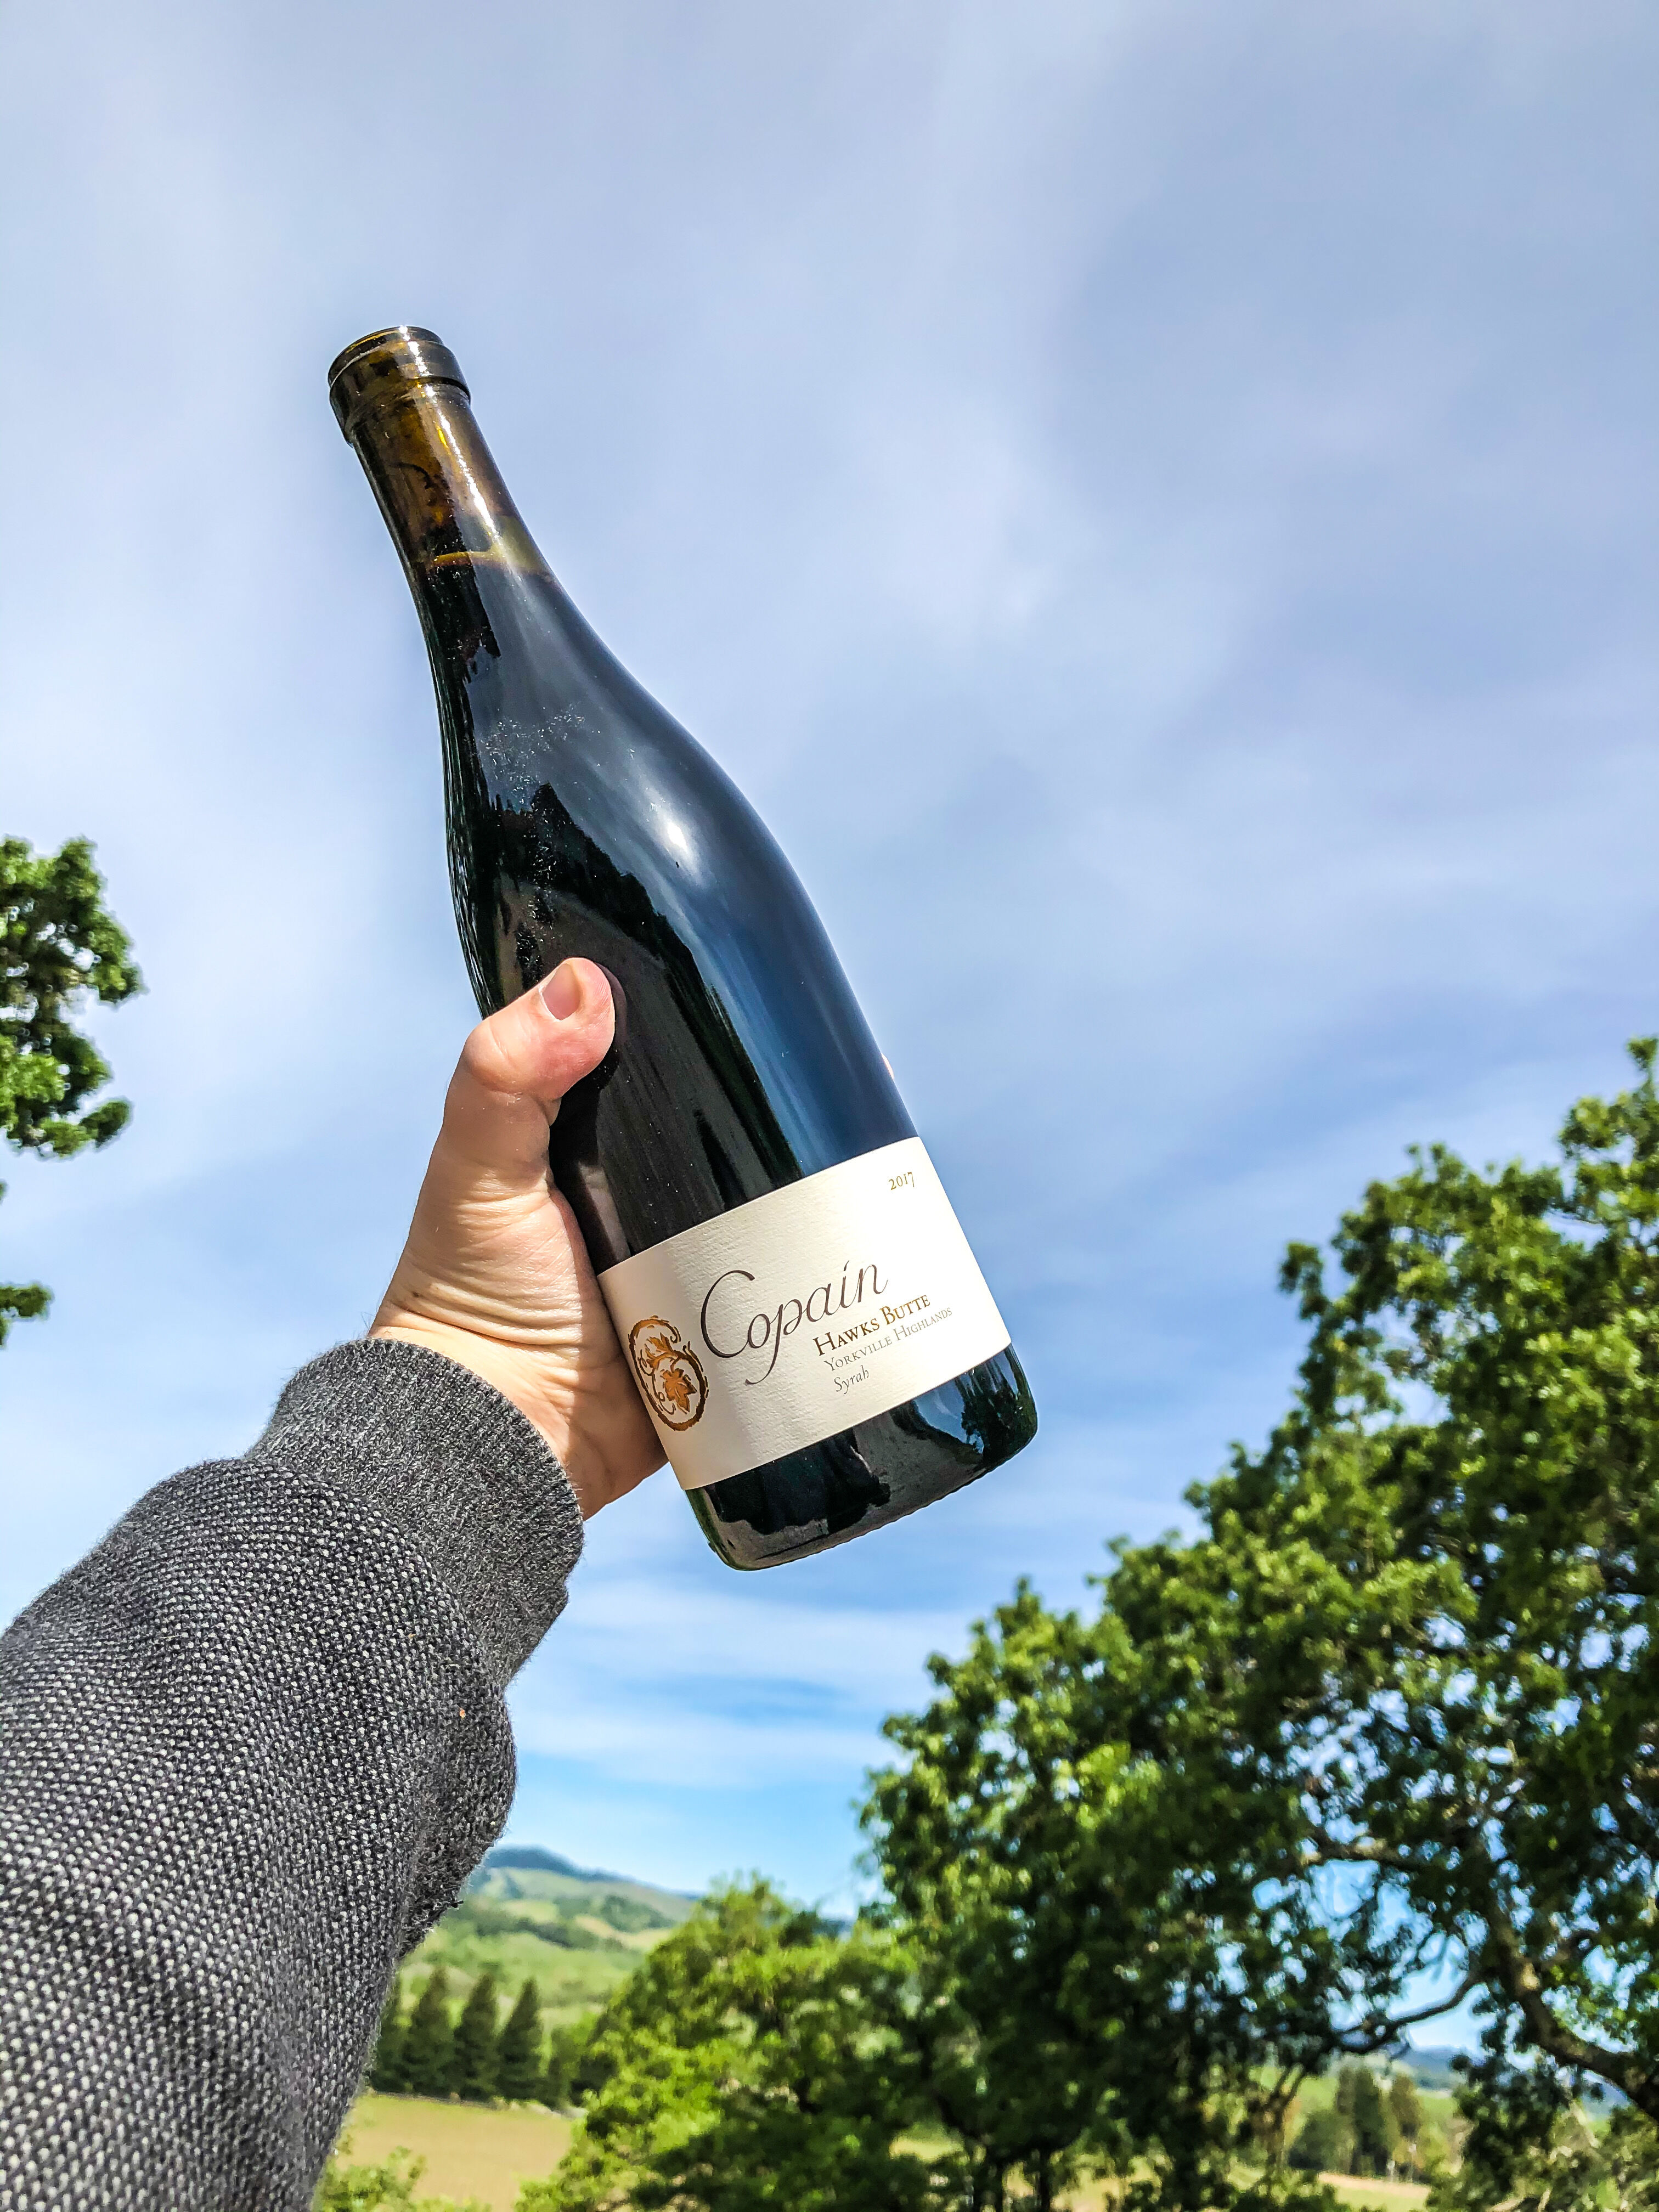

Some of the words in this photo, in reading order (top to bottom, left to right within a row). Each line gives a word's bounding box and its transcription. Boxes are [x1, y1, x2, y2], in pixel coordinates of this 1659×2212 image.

[888, 1171, 915, 1190] 2017
[700, 1260, 888, 1385] Copain
[833, 1364, 870, 1394] Syrah
